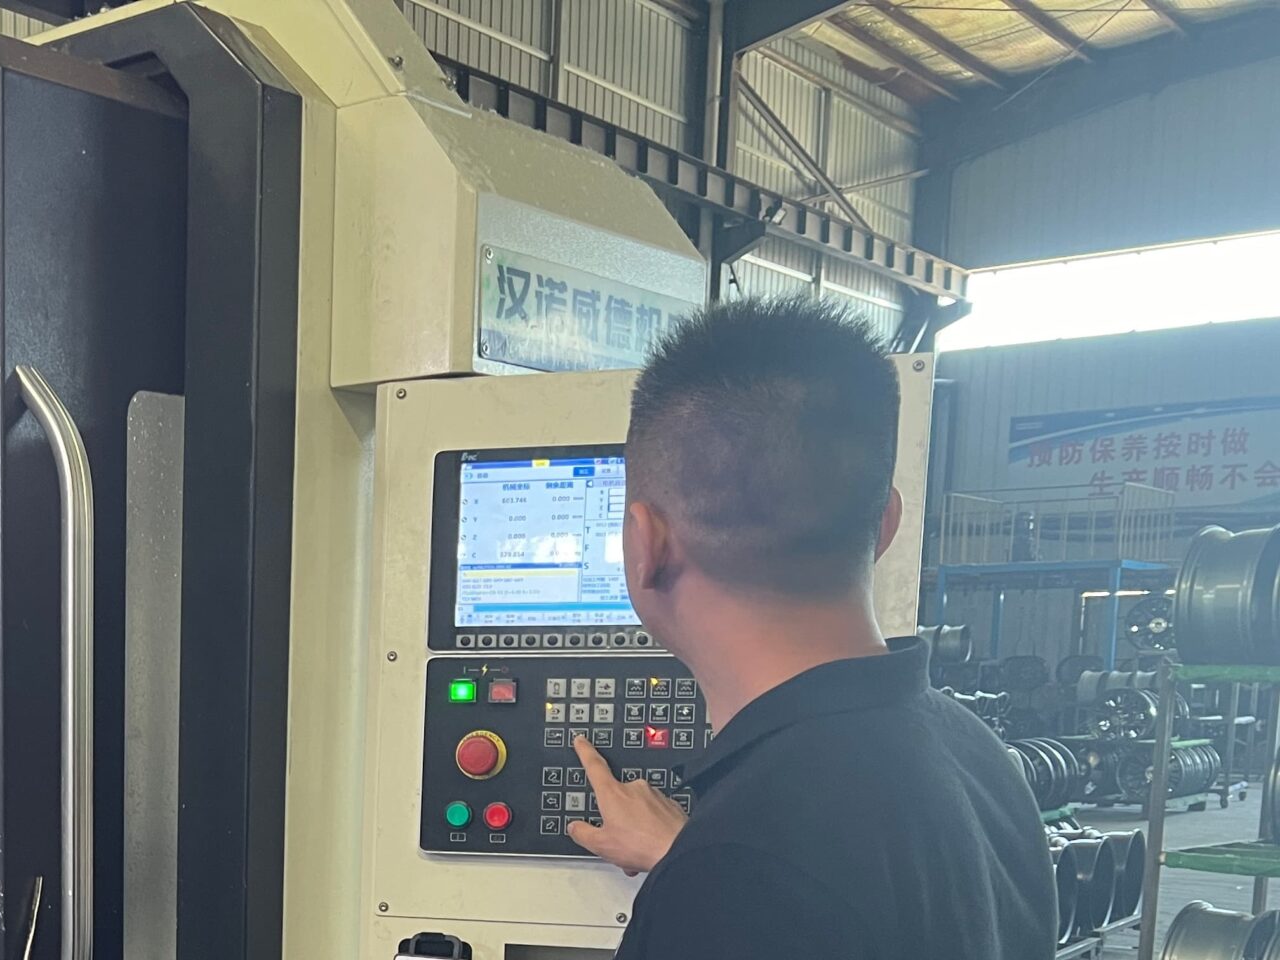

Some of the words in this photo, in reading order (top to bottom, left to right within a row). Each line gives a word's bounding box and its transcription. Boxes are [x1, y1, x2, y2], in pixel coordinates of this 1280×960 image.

[1026, 427, 1250, 468] 预防保养按时做
